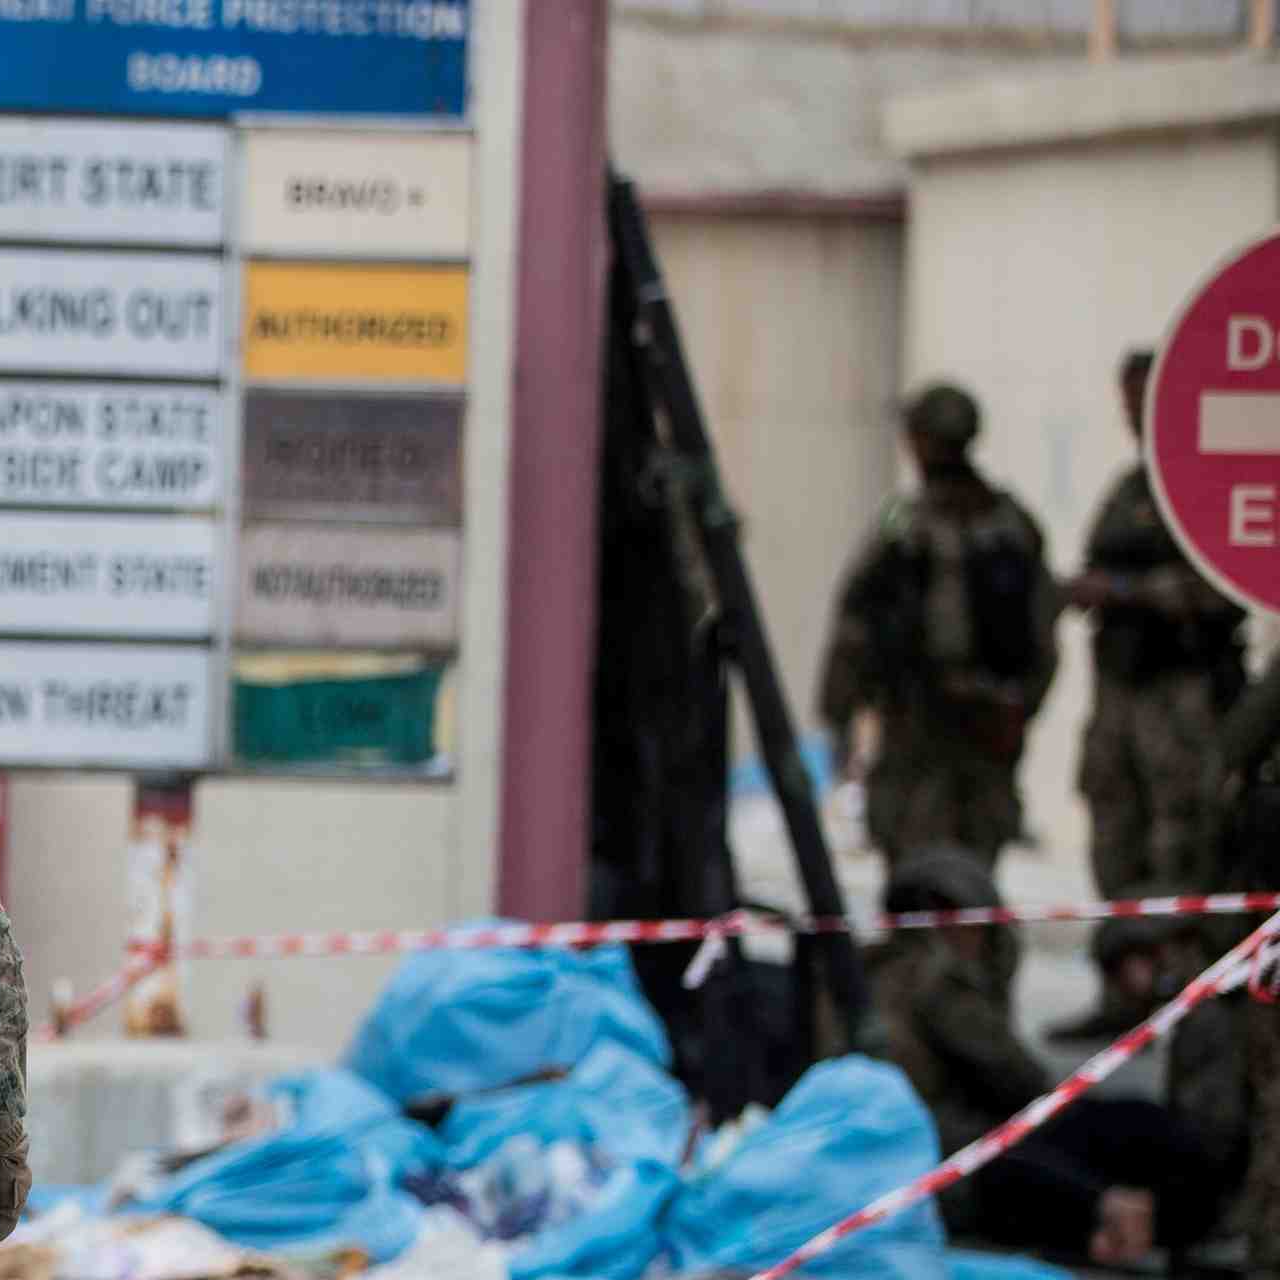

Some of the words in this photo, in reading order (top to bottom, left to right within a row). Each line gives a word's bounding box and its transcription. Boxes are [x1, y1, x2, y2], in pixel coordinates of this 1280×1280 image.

[127, 53, 261, 97] BOARD
[84, 158, 216, 210] STATE
[124, 291, 214, 339] OUT
[1226, 315, 1280, 372] D
[103, 399, 208, 440] STATE
[94, 451, 206, 493] CAMP
[112, 553, 213, 597] STATE
[42, 679, 189, 727] THREAT
